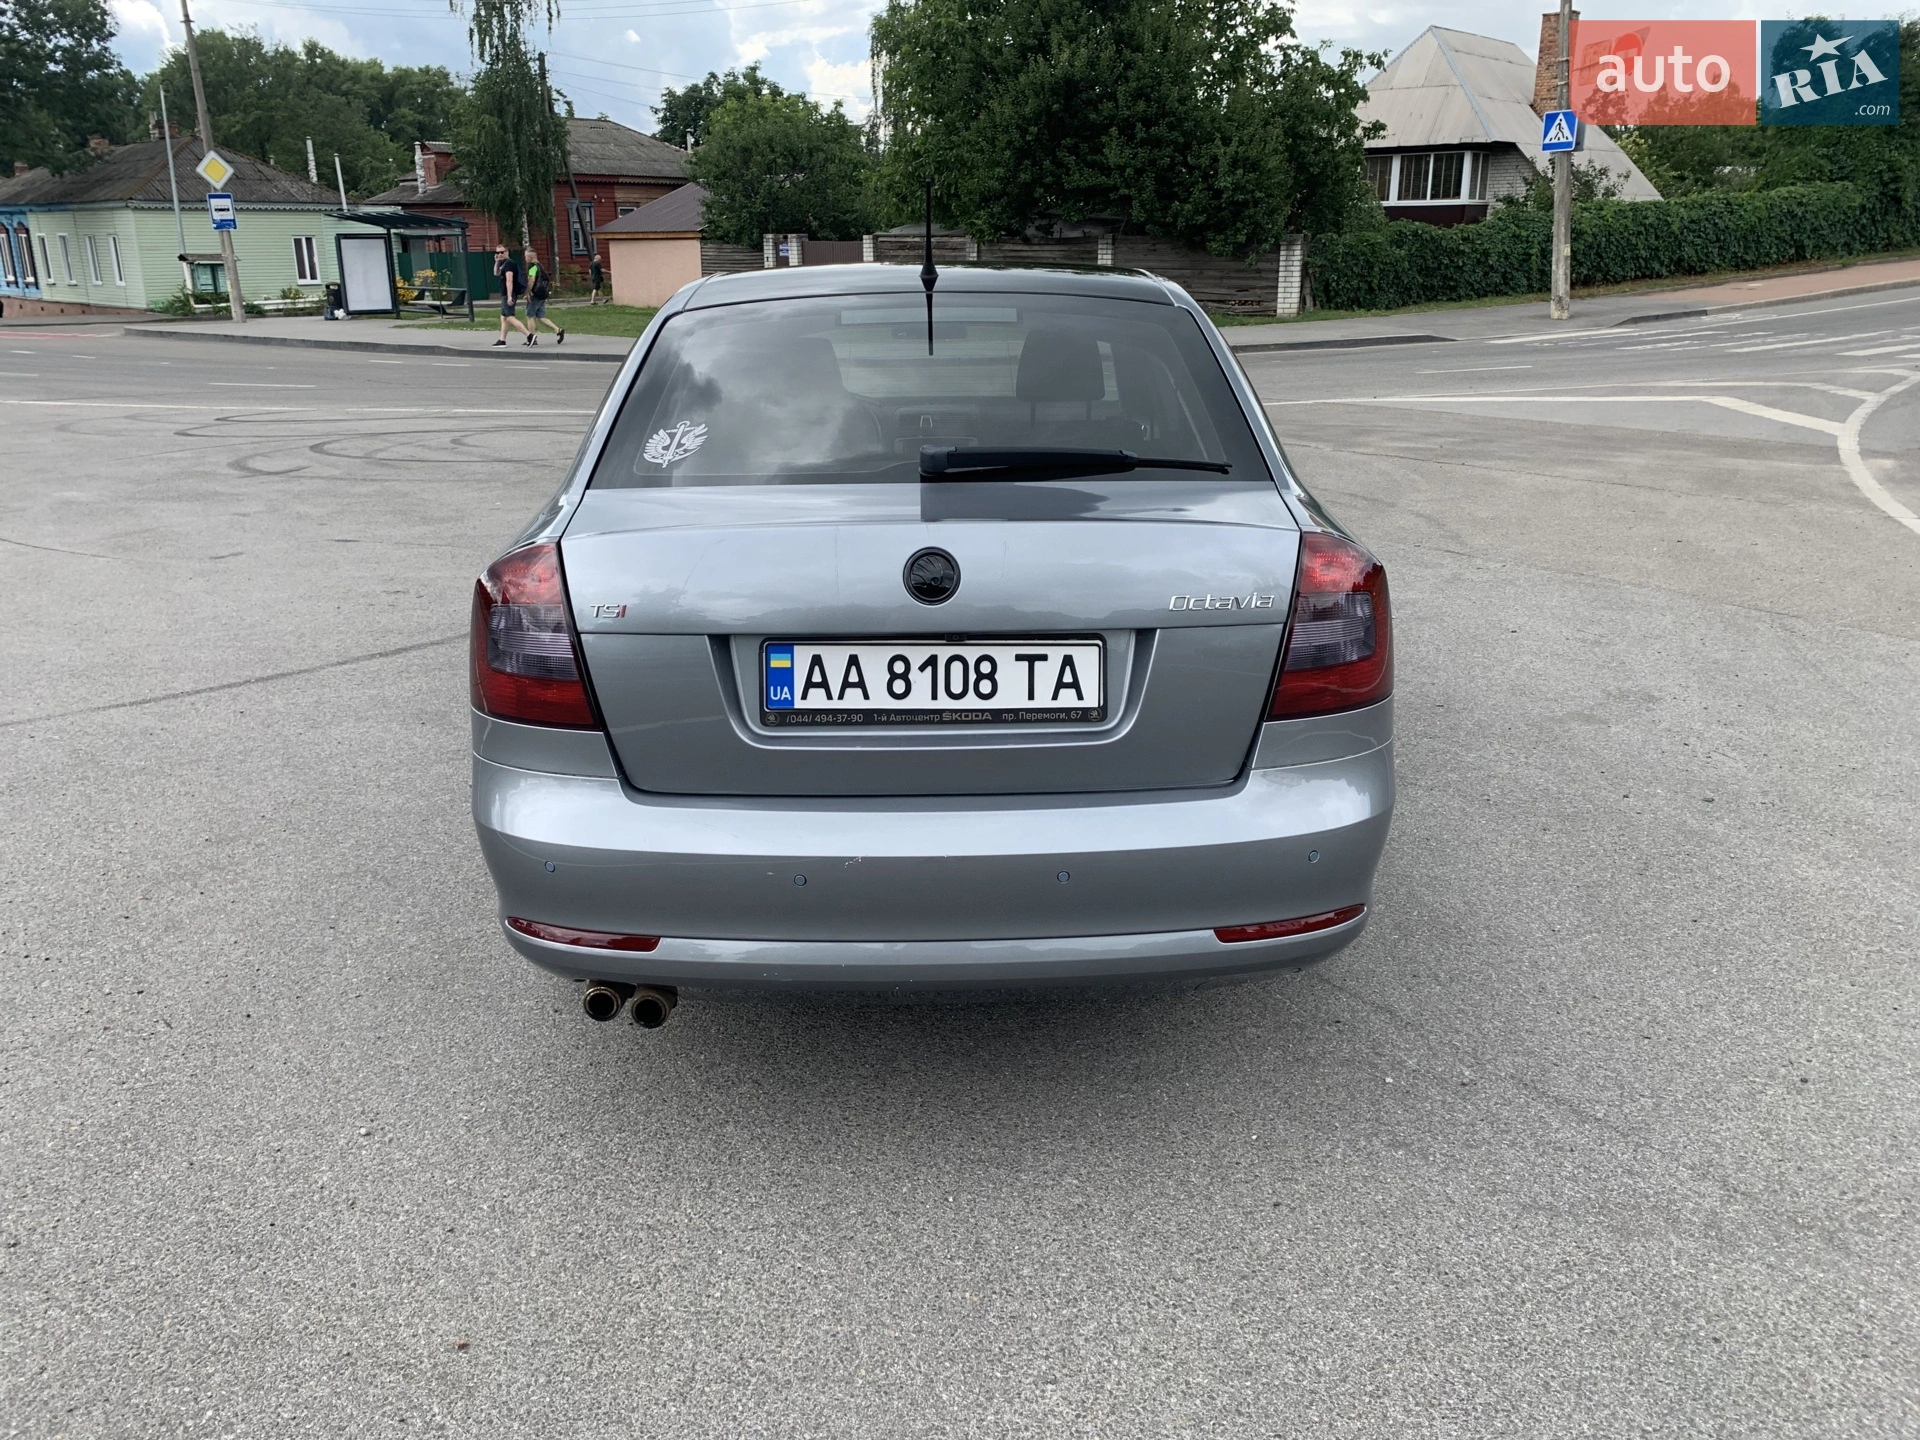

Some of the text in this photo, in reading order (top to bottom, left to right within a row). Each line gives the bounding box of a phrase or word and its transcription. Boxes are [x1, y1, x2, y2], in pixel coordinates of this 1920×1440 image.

[1169, 592, 1275, 611] Octavia
[800, 653, 1084, 701] AA 8108 TA
[770, 686, 791, 701] UA
[815, 713, 863, 722] 494-37-90
[873, 713, 887, 721] 1-й
[889, 713, 940, 722] Автоцентр
[942, 711, 992, 721] ŠKODA
[1002, 713, 1016, 721] пр.
[1019, 711, 1068, 721] Перемоги,
[1070, 710, 1082, 719] 67
